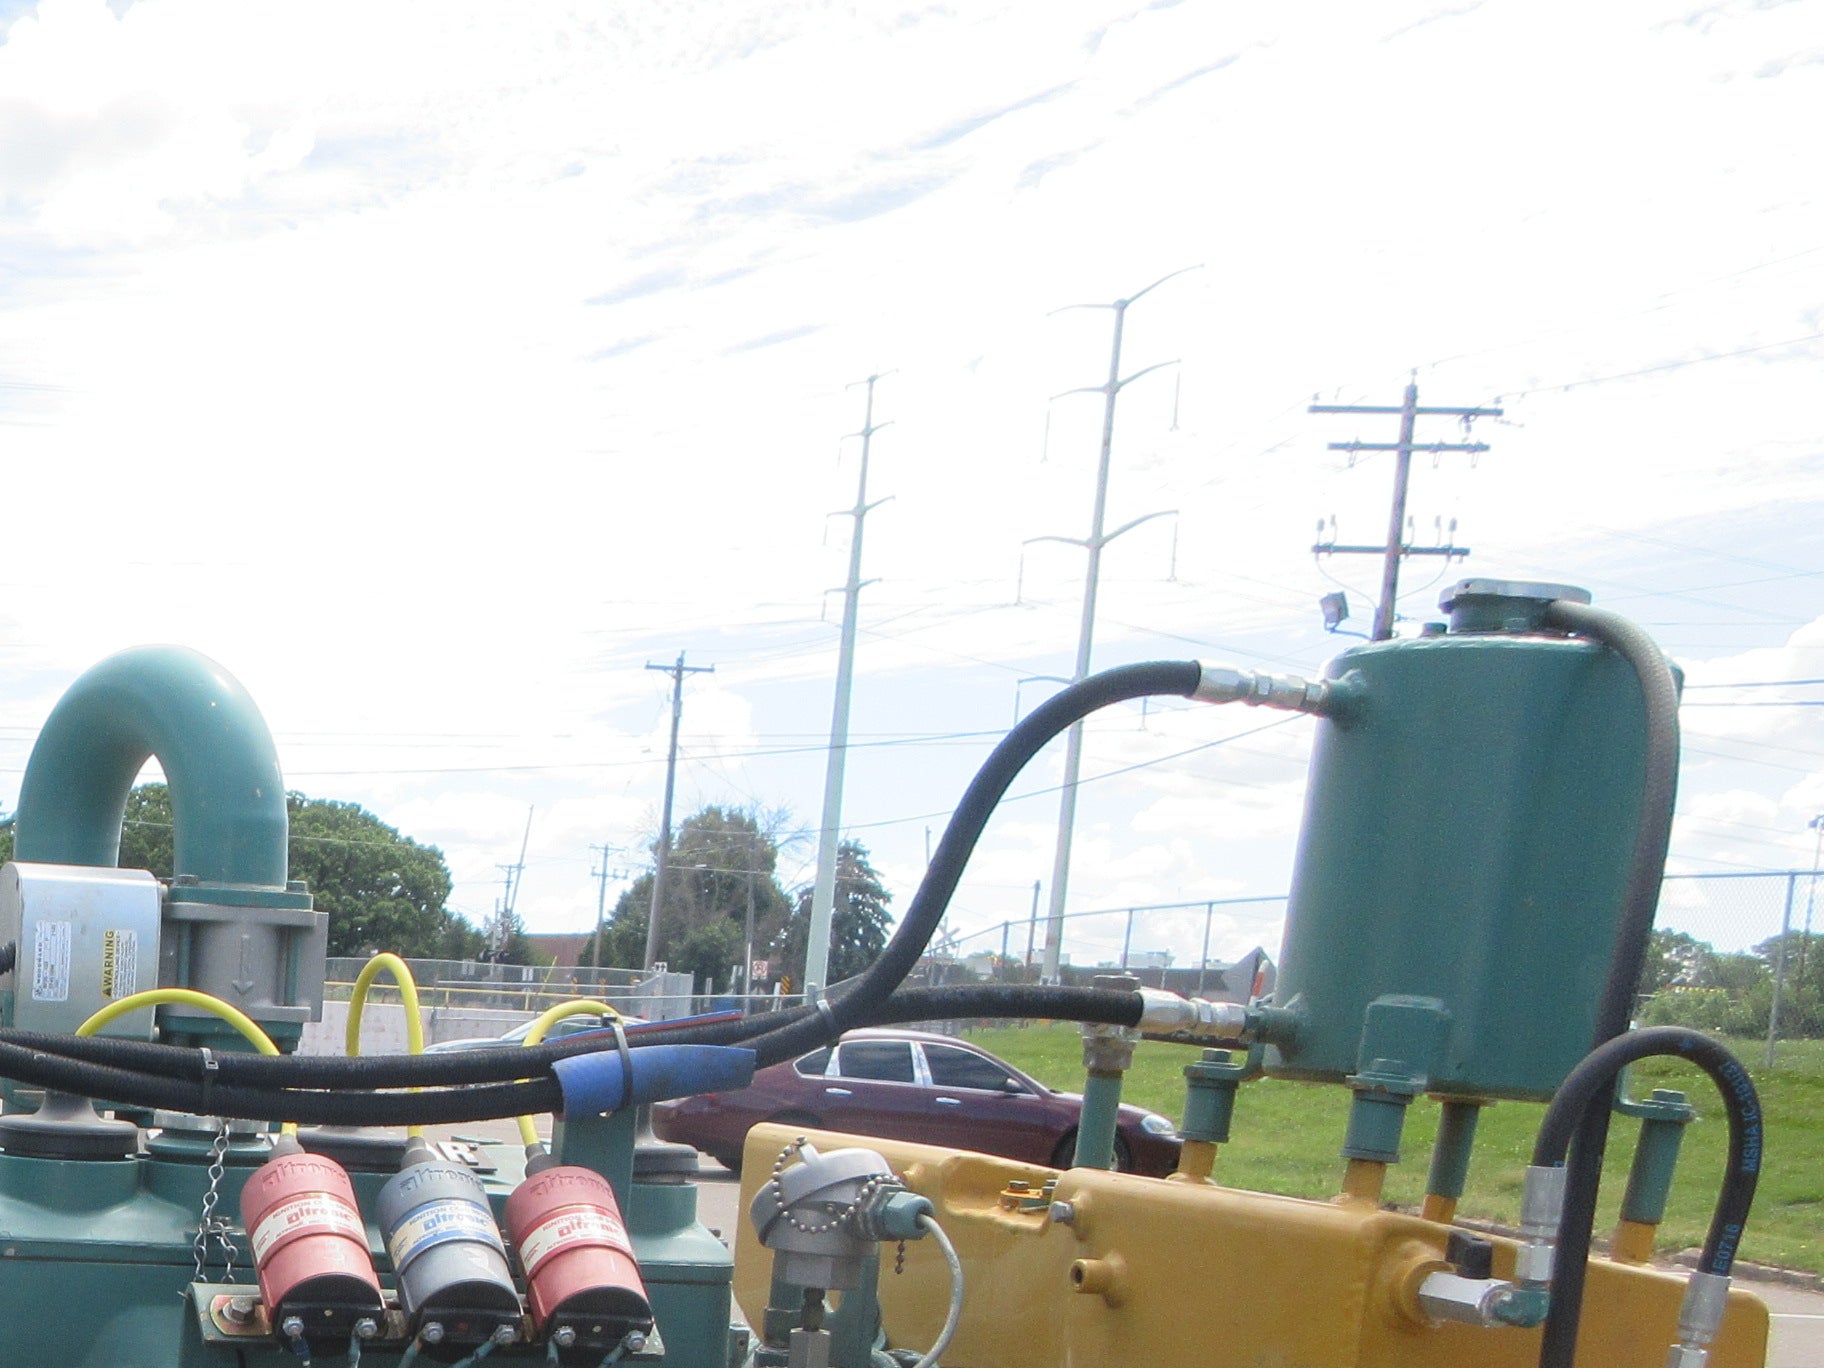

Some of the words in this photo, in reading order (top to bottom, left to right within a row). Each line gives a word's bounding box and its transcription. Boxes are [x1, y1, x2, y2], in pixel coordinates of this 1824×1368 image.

[103, 930, 114, 987] WARNING
[1743, 1124, 1760, 1172] MSHA
[272, 1200, 311, 1219] IGNITION
[286, 1206, 354, 1224] altronic
[409, 1206, 447, 1226] IGNITION
[423, 1212, 490, 1231] altronic
[542, 1214, 583, 1232] IGNITION
